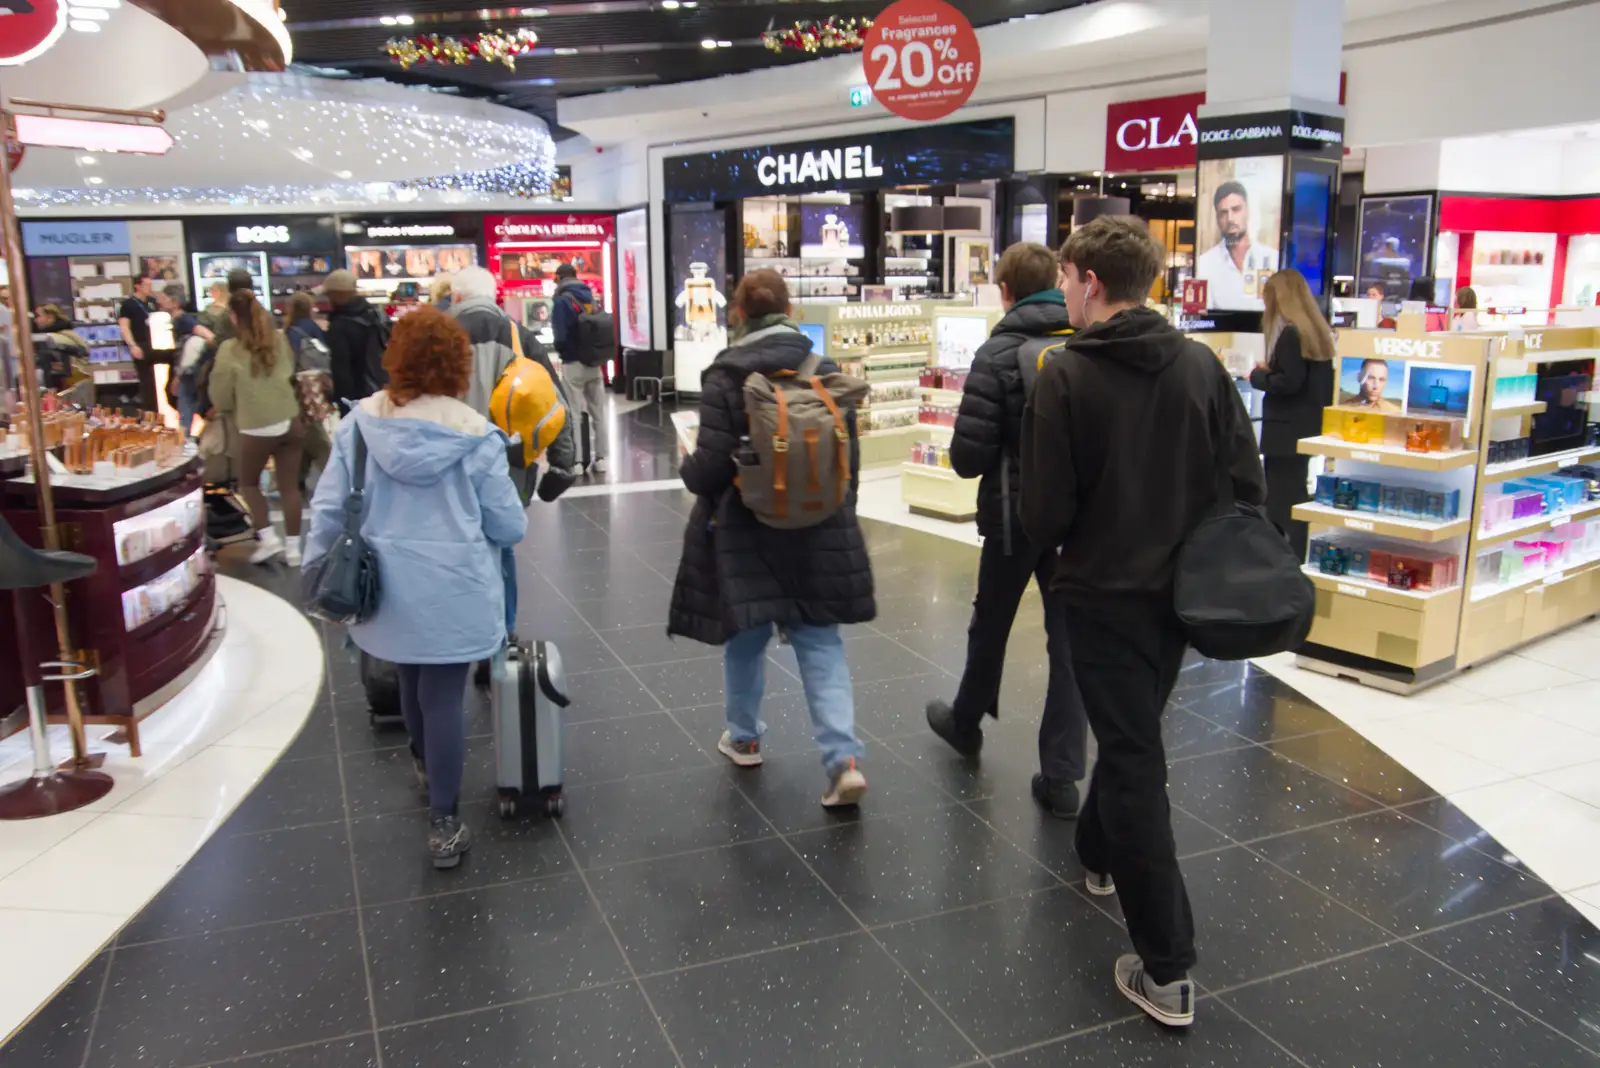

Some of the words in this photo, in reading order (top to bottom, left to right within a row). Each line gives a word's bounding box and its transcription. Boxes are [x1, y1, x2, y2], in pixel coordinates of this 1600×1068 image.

[881, 24, 957, 42] Fragrances
[757, 145, 883, 186] CHANEL
[40, 232, 113, 244] MUGLER
[236, 226, 290, 243] BOSS
[494, 225, 551, 236] CAROLINA
[551, 224, 604, 235] HERRERA
[838, 304, 922, 319] PENHALIGON'S
[1373, 337, 1443, 358] VERSACE
